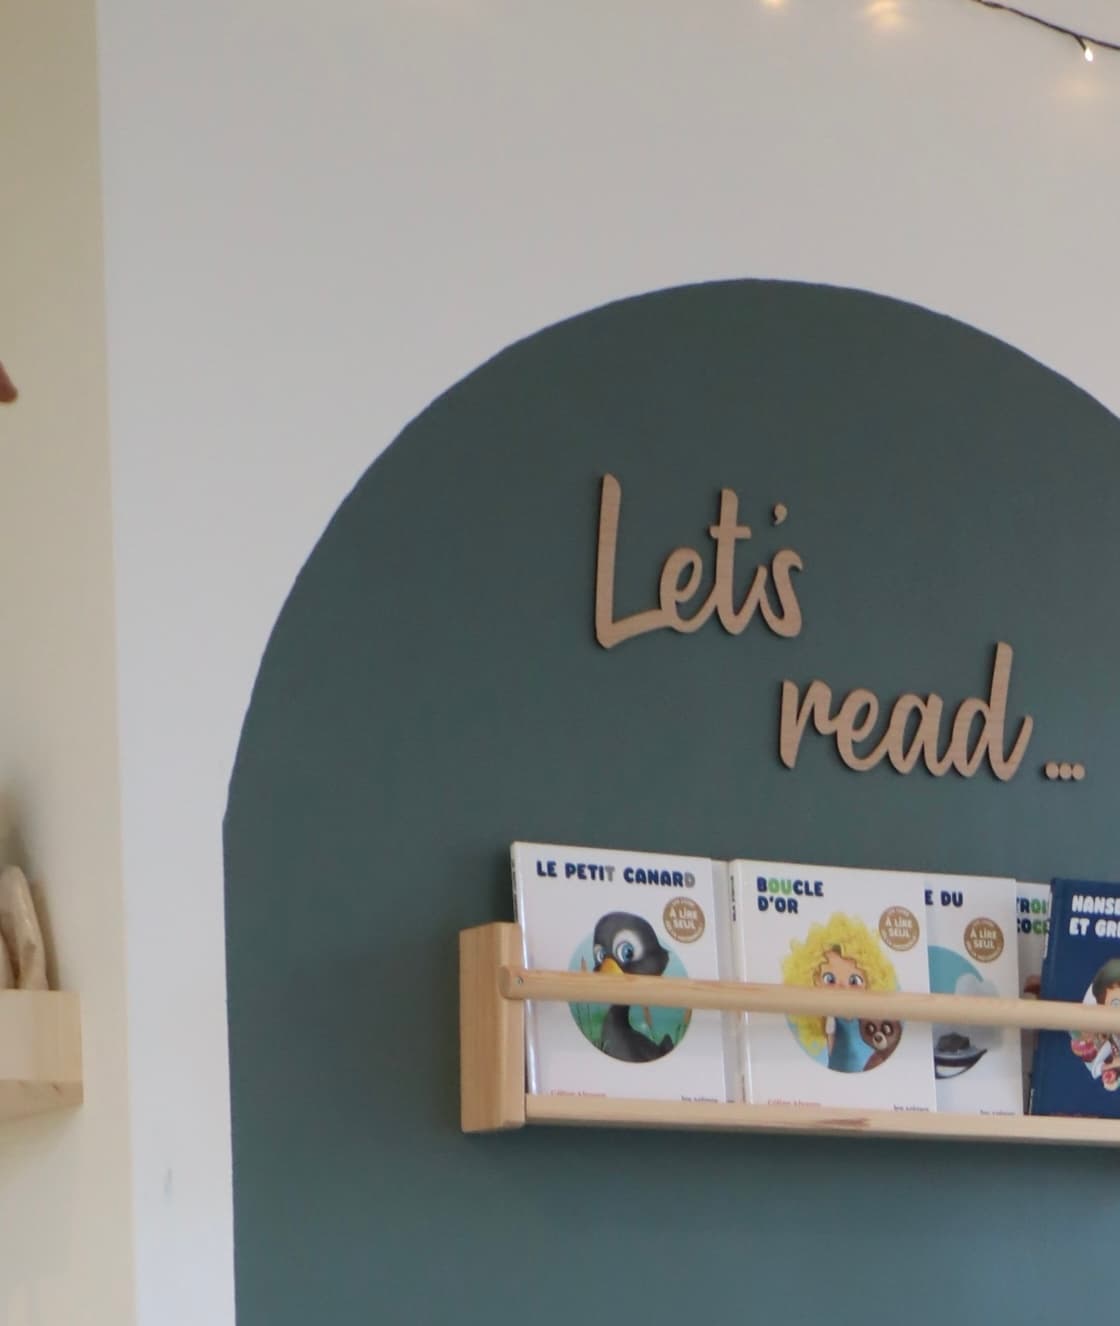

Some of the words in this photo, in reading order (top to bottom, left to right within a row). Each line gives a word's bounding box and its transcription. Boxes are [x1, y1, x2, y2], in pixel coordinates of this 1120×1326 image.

[595, 473, 803, 649] Let's
[536, 860, 558, 877] LE
[564, 861, 615, 882] PETIT
[623, 866, 696, 888] CANARD
[756, 876, 824, 897] BOUCLE
[757, 894, 799, 914] D'OR
[940, 890, 964, 907] DU
[1016, 896, 1050, 915] ROI
[888, 926, 911, 938] SEUL
[1069, 917, 1091, 936] ET
[972, 938, 995, 950] SEUL
